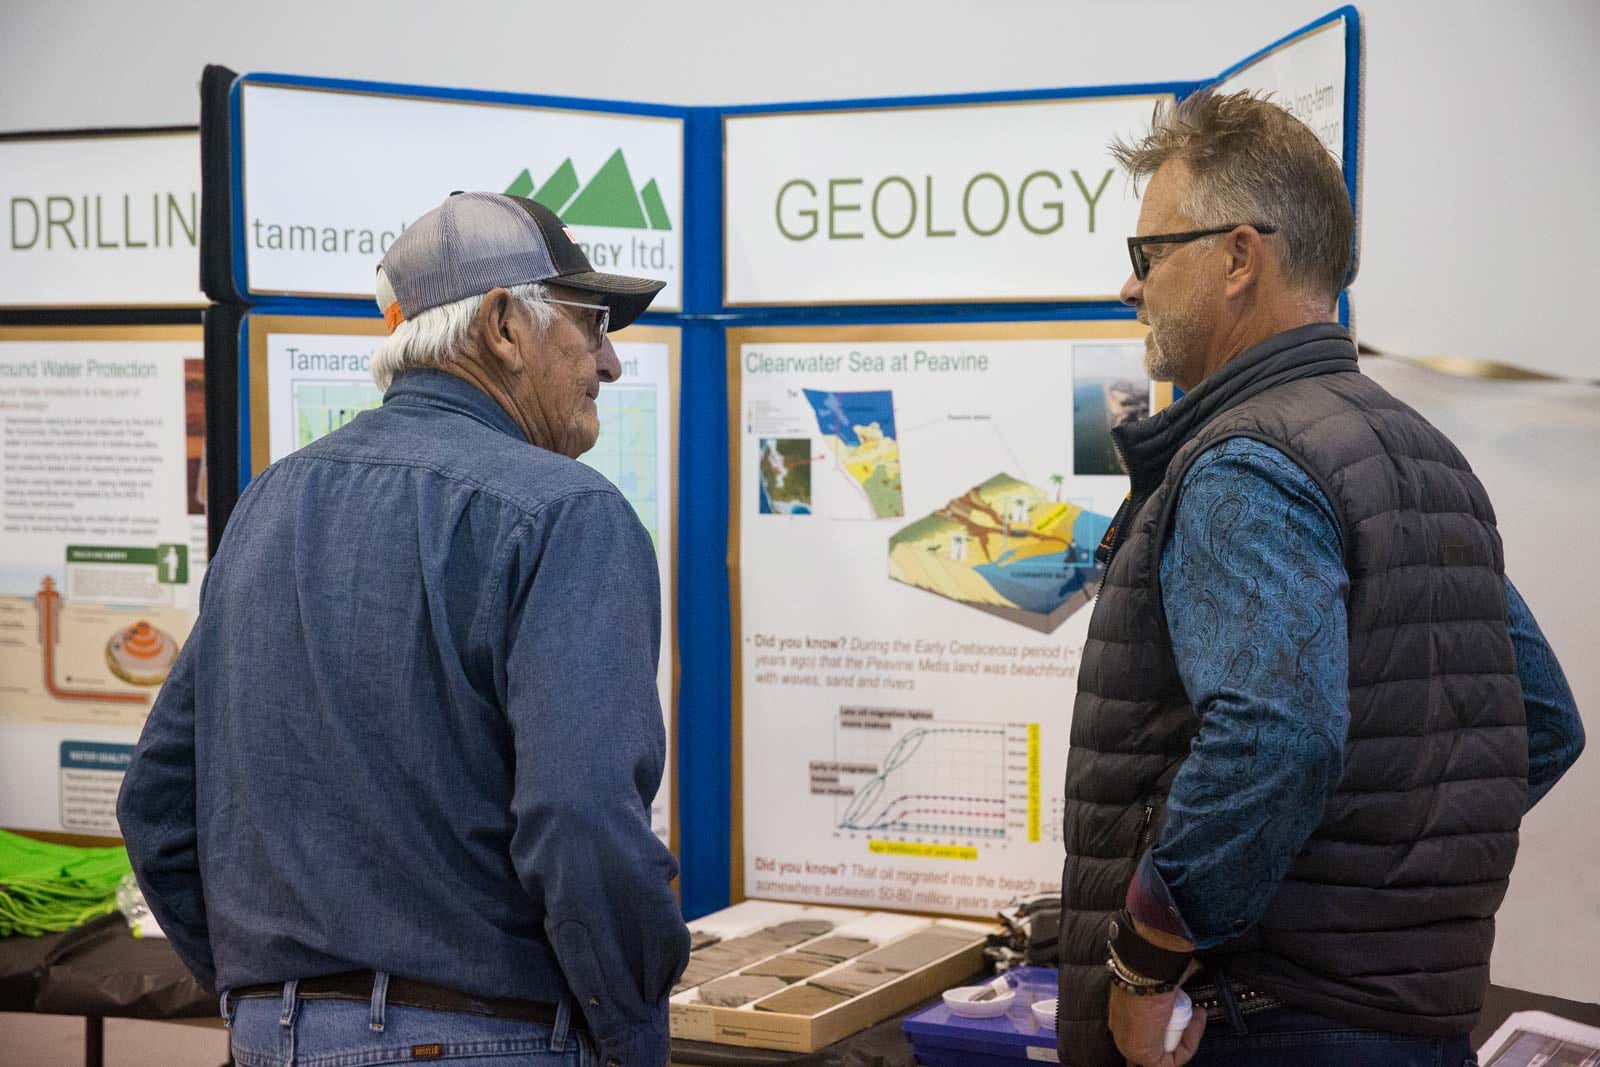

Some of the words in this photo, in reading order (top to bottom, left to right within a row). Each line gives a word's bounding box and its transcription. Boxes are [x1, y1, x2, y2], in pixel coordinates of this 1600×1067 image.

[776, 169, 1114, 241] GEOLOGY
[10, 192, 197, 250] DRILLIN
[252, 218, 405, 255] tamarac
[580, 242, 622, 267] RGY
[632, 235, 674, 270] ltd.
[0, 361, 38, 378] round
[40, 360, 82, 378] Water
[86, 358, 158, 378] Protection
[286, 348, 374, 371] Tamarac
[745, 351, 842, 374] Clearwater
[848, 351, 885, 373] Sea
[891, 354, 908, 373] at
[914, 350, 989, 373] Peavine
[754, 633, 775, 648] Did
[778, 638, 802, 652] you
[805, 635, 847, 649] know?
[850, 636, 890, 654] During
[893, 637, 912, 652] the
[915, 639, 945, 657] Early
[949, 640, 1018, 657] Cretaceous
[1021, 644, 1060, 661] period
[755, 656, 786, 668] years
[819, 655, 842, 668] that
[845, 656, 863, 669] the
[867, 656, 914, 671] Peavine
[952, 660, 979, 673] land
[982, 663, 1008, 675] was
[1010, 662, 1075, 679] beachfront
[755, 672, 778, 684] with
[825, 674, 854, 688] sand
[857, 675, 881, 688] and
[755, 856, 775, 872] Did
[778, 861, 802, 876] you
[805, 860, 847, 876] know?
[852, 863, 877, 879] That
[880, 865, 894, 881] oil
[896, 868, 949, 887] migrated
[951, 871, 973, 887] into
[975, 873, 993, 888] the
[998, 876, 1036, 891] beach
[756, 879, 824, 896] somewhere
[825, 883, 876, 898] between
[916, 888, 953, 904] million
[955, 895, 989, 910] years
